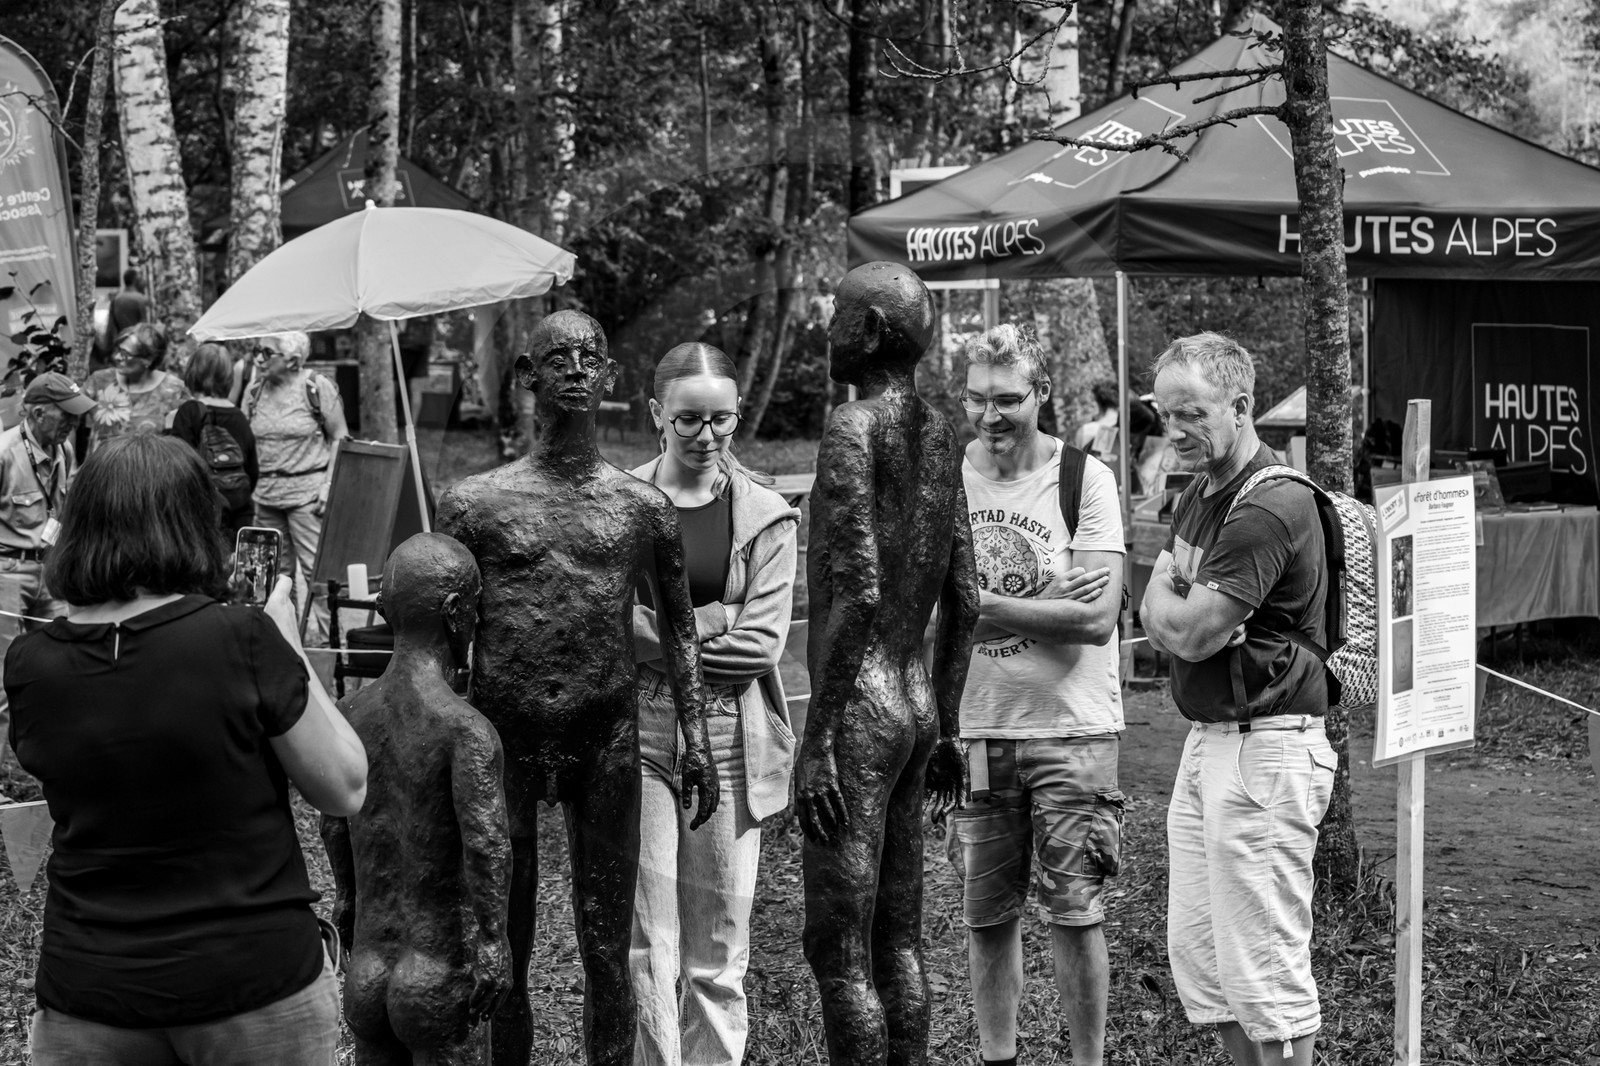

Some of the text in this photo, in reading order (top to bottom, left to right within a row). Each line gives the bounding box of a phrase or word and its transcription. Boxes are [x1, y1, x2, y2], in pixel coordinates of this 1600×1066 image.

[1333, 118, 1400, 136] UTES
[1335, 133, 1416, 157] LPES
[906, 218, 1046, 262] HAUTES ALPES
[1278, 214, 1558, 257] HUTES ALPES
[1485, 382, 1580, 423] HAUTES
[970, 509, 1053, 544] RTAD HASTA
[977, 637, 1038, 659] MUERT
